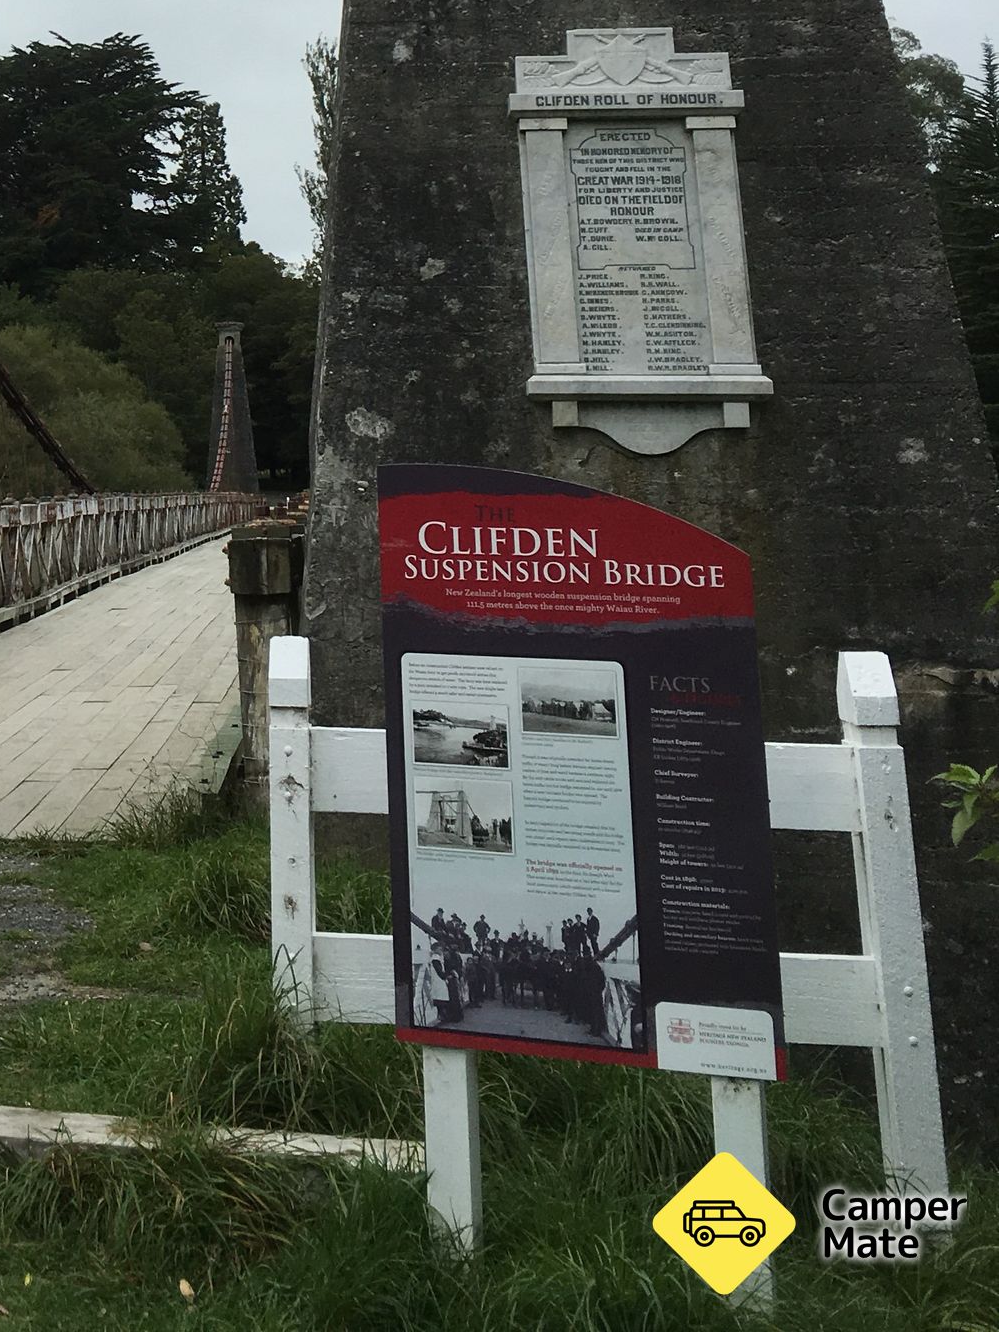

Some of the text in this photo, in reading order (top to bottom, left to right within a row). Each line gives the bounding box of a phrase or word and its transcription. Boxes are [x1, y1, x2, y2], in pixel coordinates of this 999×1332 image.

[535, 95, 589, 106] CLIFDEN
[594, 94, 629, 105] ROLL
[637, 94, 653, 105] OF
[601, 132, 650, 141] ERECTED
[581, 148, 589, 156] IN
[591, 148, 629, 156] HONORED
[577, 175, 681, 185] GREAT WAR 1914-1918
[578, 195, 685, 205] DIED ON THE FIELD OF
[610, 207, 655, 216] HONOUR
[474, 504, 514, 522] THE
[417, 520, 599, 558] CLIFDEN
[404, 554, 725, 588] SUSPENSION BRIDGE
[445, 588, 681, 604] New Zealand's longest wooden suspension bridge spanning
[486, 602, 513, 610] metres
[515, 602, 539, 610] above
[575, 604, 604, 613] mighty
[606, 604, 633, 613] Waiau
[635, 605, 660, 614] River.
[650, 675, 711, 693] FACTS
[657, 817, 695, 826] Construction
[525, 858, 536, 866] The
[537, 859, 555, 867] bridge
[568, 861, 592, 870] officially
[593, 864, 614, 872] opened
[660, 858, 679, 866] Height
[531, 866, 544, 874] April
